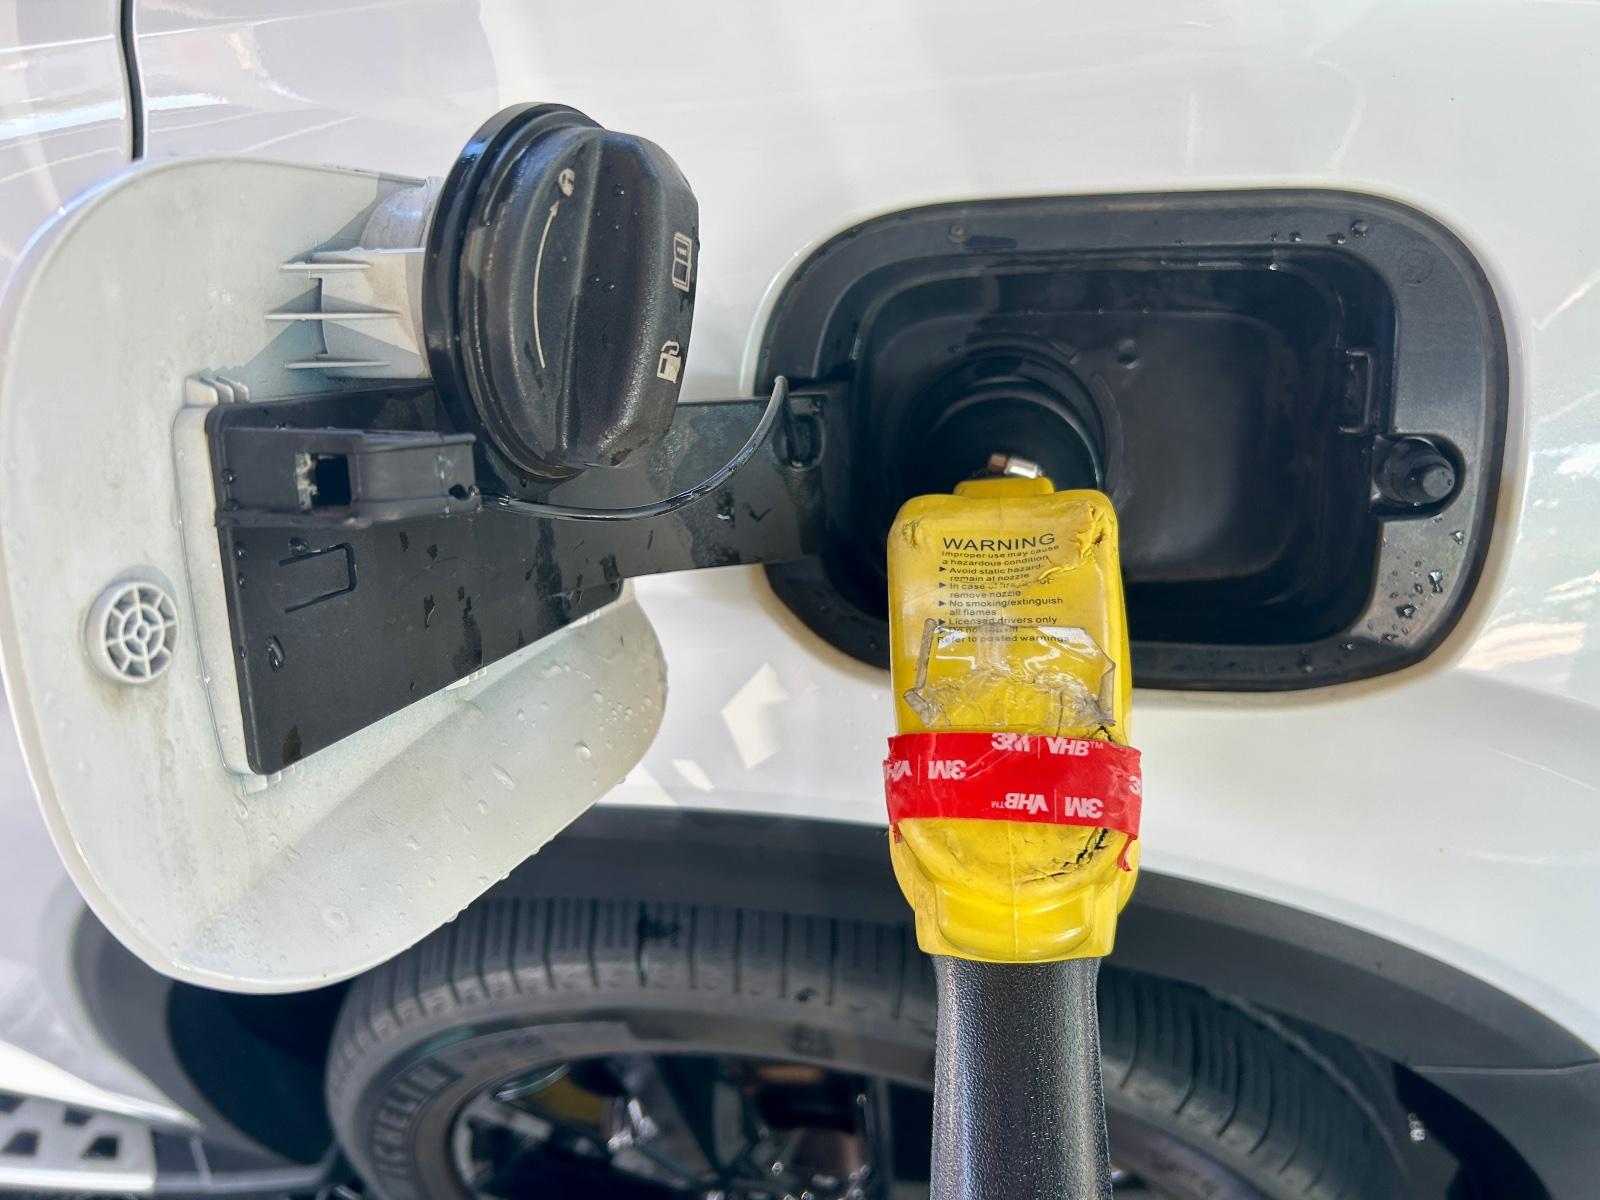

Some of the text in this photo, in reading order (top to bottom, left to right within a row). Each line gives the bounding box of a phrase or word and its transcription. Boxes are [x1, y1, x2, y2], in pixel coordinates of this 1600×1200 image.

[943, 533, 1055, 551] WARNING
[941, 550, 985, 558] Improper
[1008, 550, 1028, 558] may
[1030, 545, 1059, 555] cause
[950, 558, 1002, 566] hazardous
[1004, 555, 1049, 565] condition
[997, 573, 1030, 581] nozzle
[989, 590, 1022, 598] nozzle
[966, 598, 1063, 608] smoking/extinguish
[996, 616, 1033, 625] drivers
[1036, 615, 1058, 625] only
[979, 635, 1018, 643] posted
[927, 759, 967, 780] 3M
[1064, 796, 1105, 819] 3M
